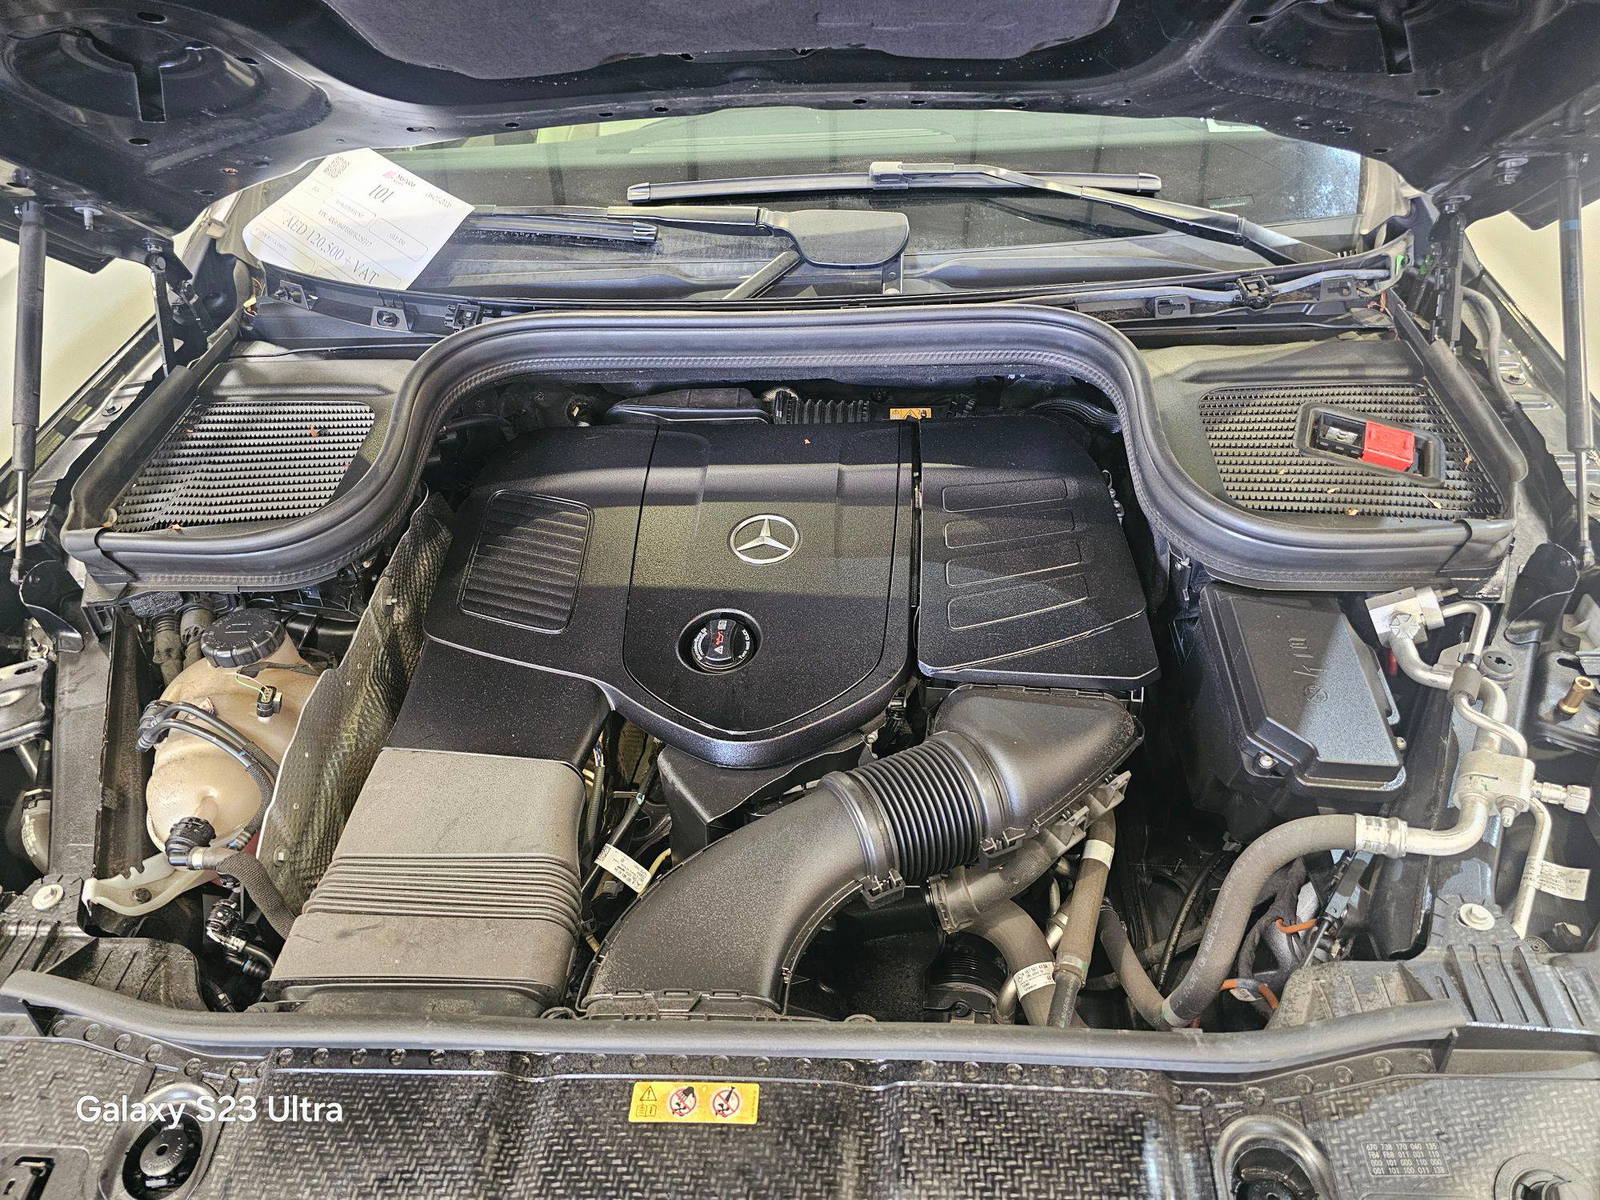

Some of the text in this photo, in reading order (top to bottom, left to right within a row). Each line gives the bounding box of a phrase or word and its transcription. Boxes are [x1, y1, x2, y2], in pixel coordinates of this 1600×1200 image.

[368, 184, 395, 203] 101
[282, 215, 308, 235] AED
[353, 259, 380, 284] VAT
